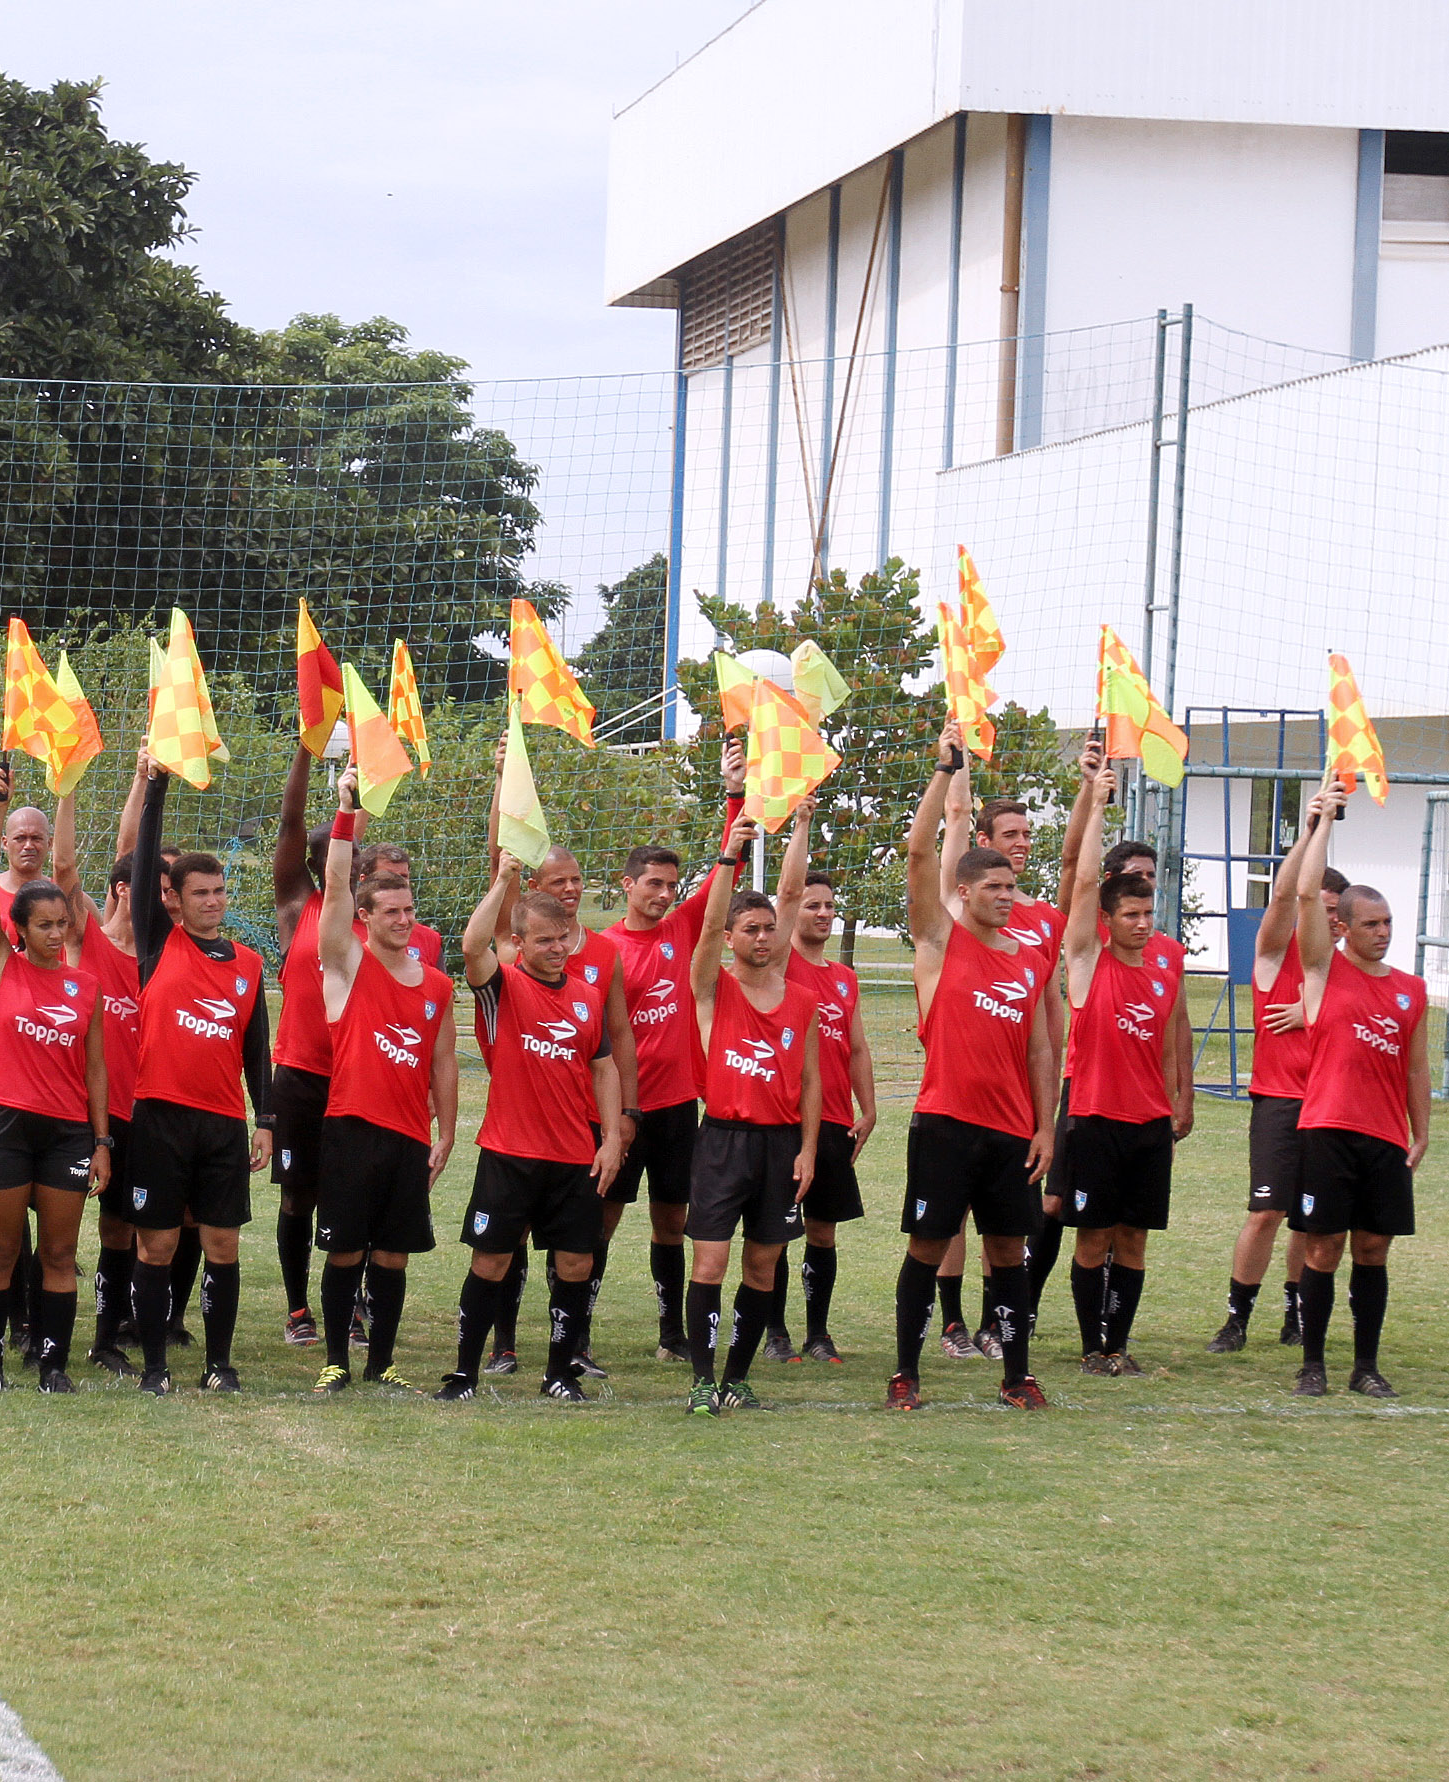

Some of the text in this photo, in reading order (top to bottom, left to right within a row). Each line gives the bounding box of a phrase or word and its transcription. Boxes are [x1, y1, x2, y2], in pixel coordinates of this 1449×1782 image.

[15, 1015, 77, 1048] Topper
[176, 1009, 233, 1040] Topper
[373, 1031, 419, 1068] Topper
[999, 1319, 1015, 1343] Topper
